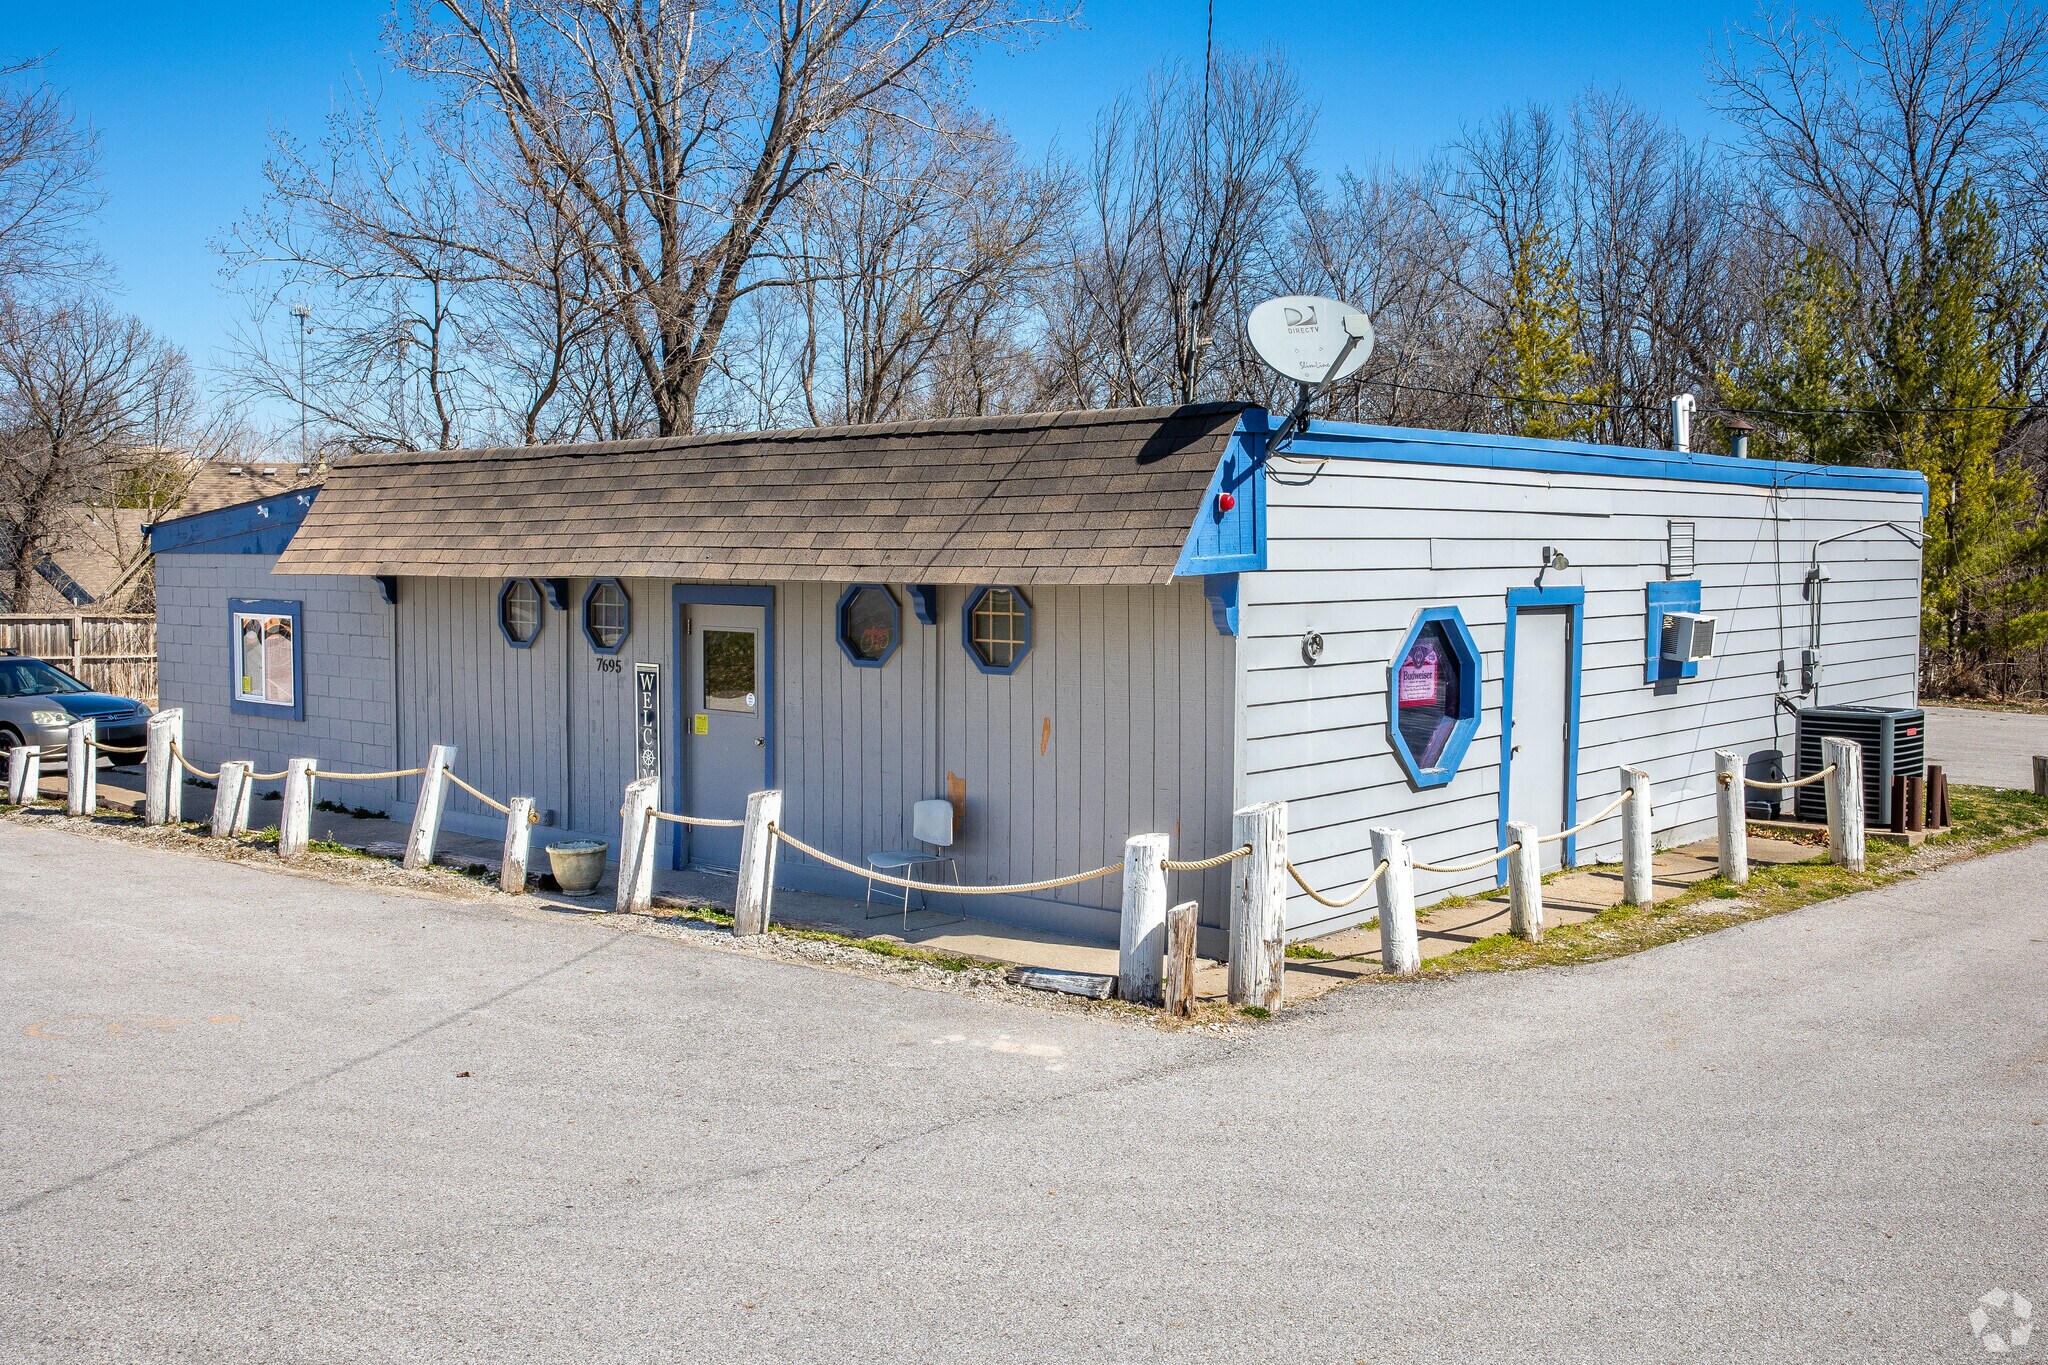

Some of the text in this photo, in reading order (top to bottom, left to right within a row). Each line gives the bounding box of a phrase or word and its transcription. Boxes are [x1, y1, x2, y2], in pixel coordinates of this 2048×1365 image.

[1288, 326, 1319, 334] DIRECTV
[596, 658, 622, 673] 7695
[1403, 670, 1432, 680] Budweiser
